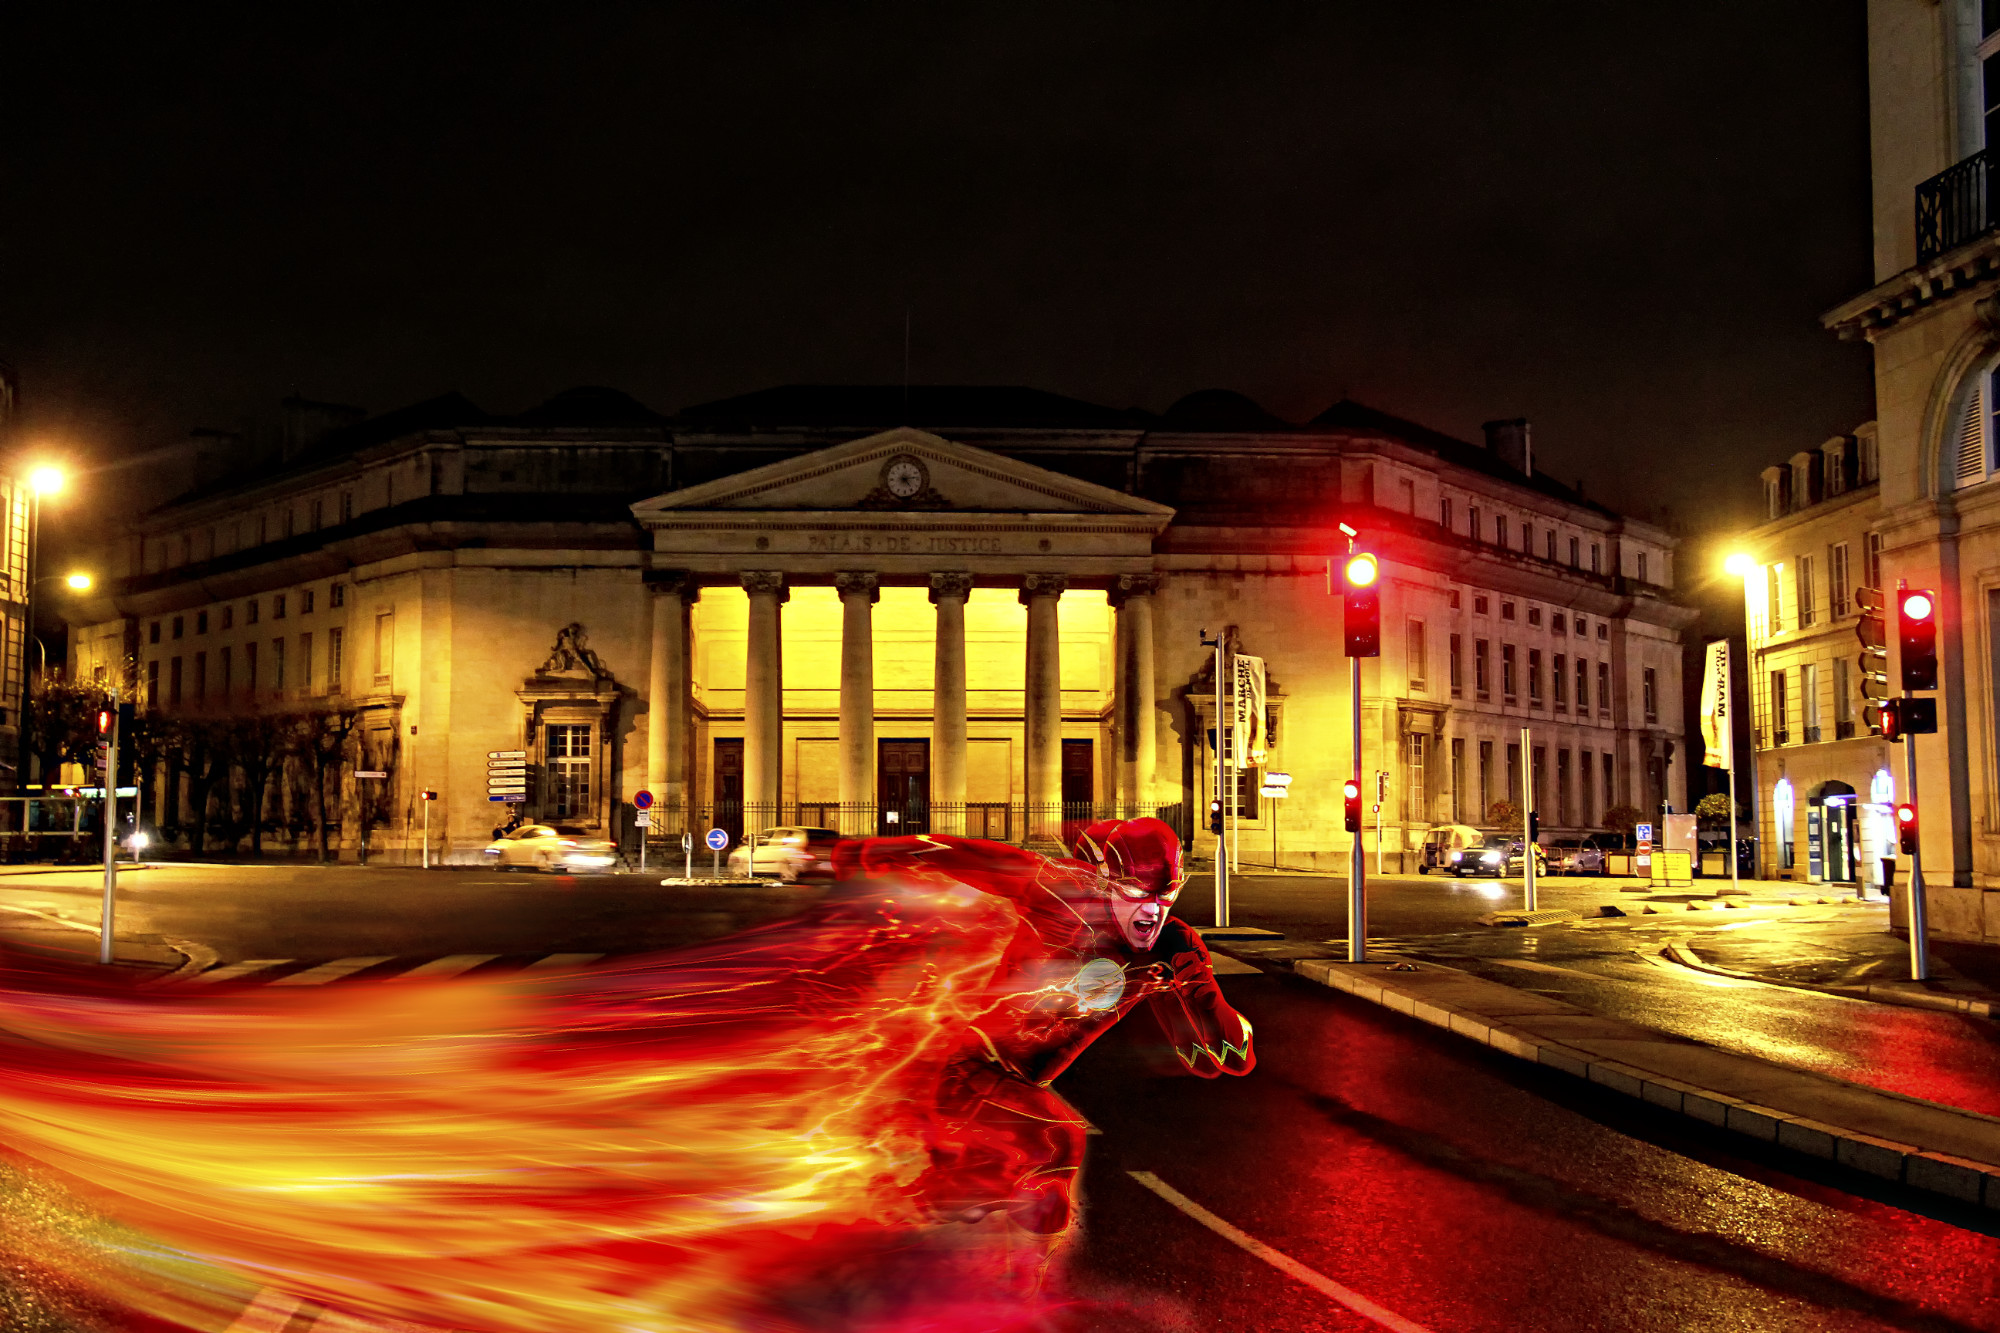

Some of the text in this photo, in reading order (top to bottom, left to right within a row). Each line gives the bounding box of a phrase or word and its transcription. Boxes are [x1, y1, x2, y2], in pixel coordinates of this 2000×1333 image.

[809, 537, 1001, 552] PALAIS DE JUSTICE
[1237, 659, 1246, 722] MARCHE
